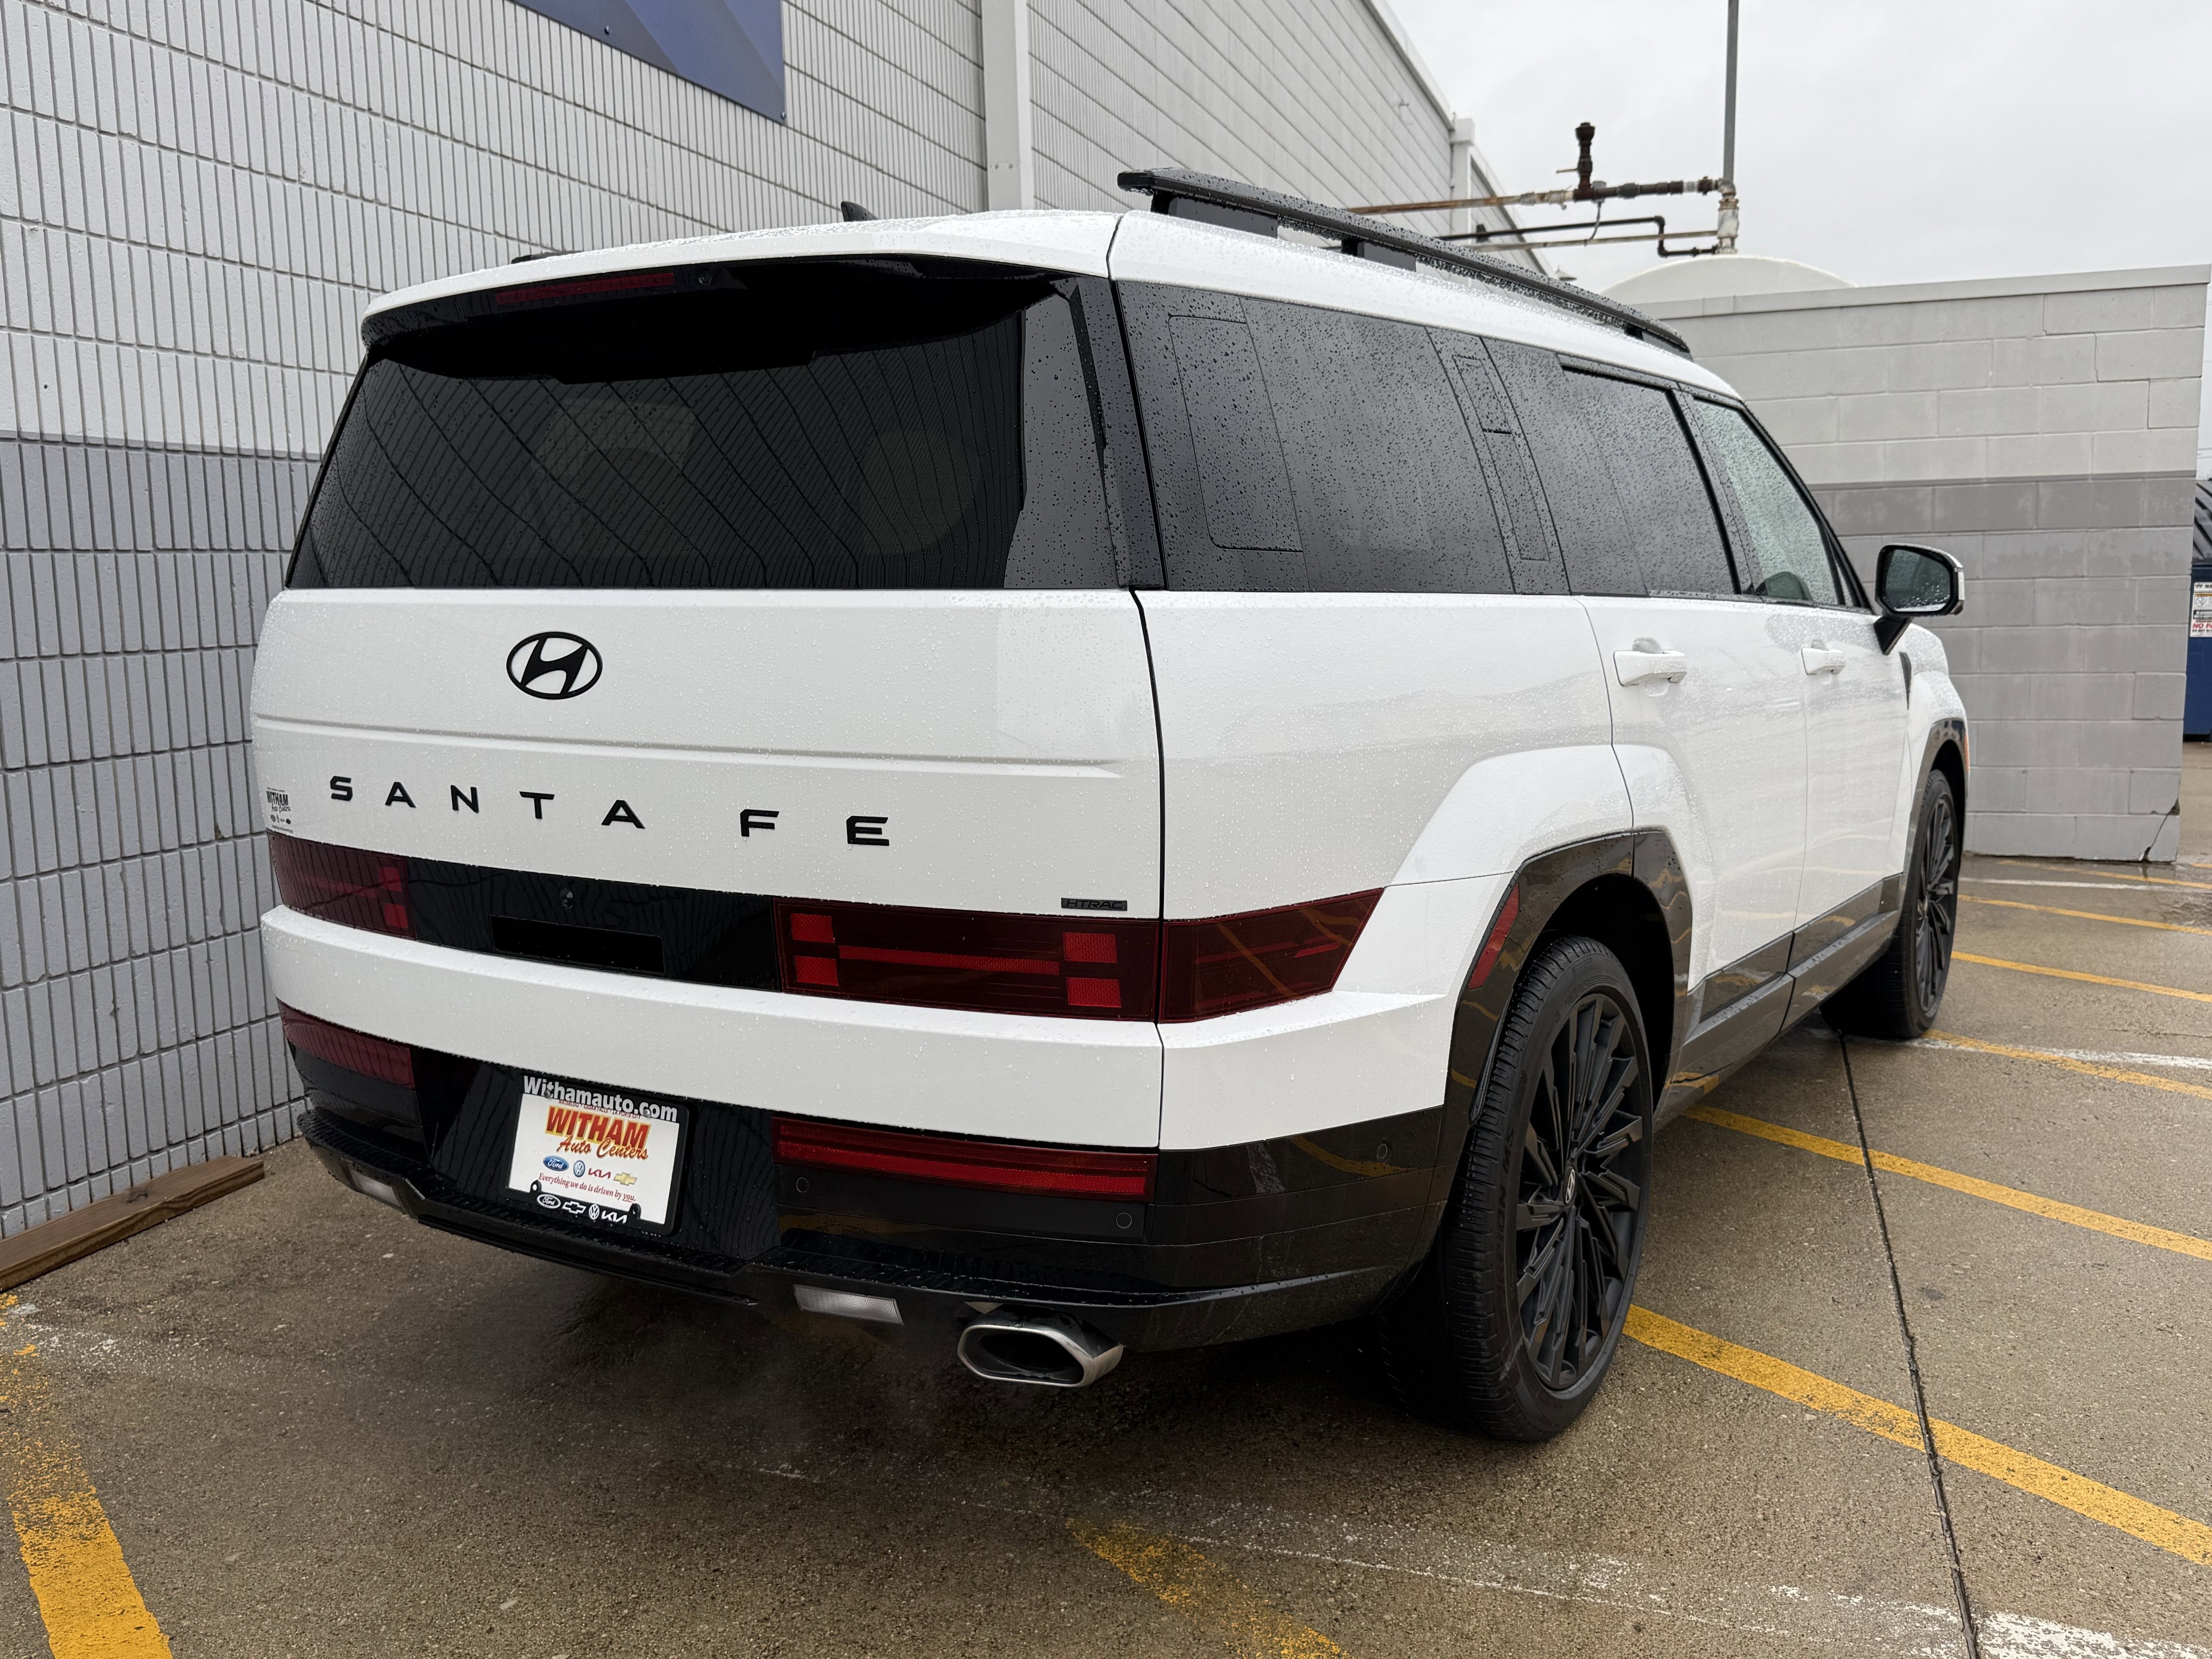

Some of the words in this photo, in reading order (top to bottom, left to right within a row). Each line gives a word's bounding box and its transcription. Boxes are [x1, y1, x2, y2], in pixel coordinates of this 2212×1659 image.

[330, 776, 646, 830] SANTA
[740, 809, 890, 846] FE
[1066, 900, 1123, 908] HTRAC
[524, 1075, 677, 1122] Withamauto.com
[545, 1105, 651, 1150] WITHAM
[556, 1135, 592, 1154] Auto
[596, 1137, 649, 1160] Centers
[539, 1173, 570, 1188] Everything
[579, 1182, 587, 1190] do
[594, 1185, 614, 1197] driven
[615, 1190, 622, 1200] by
